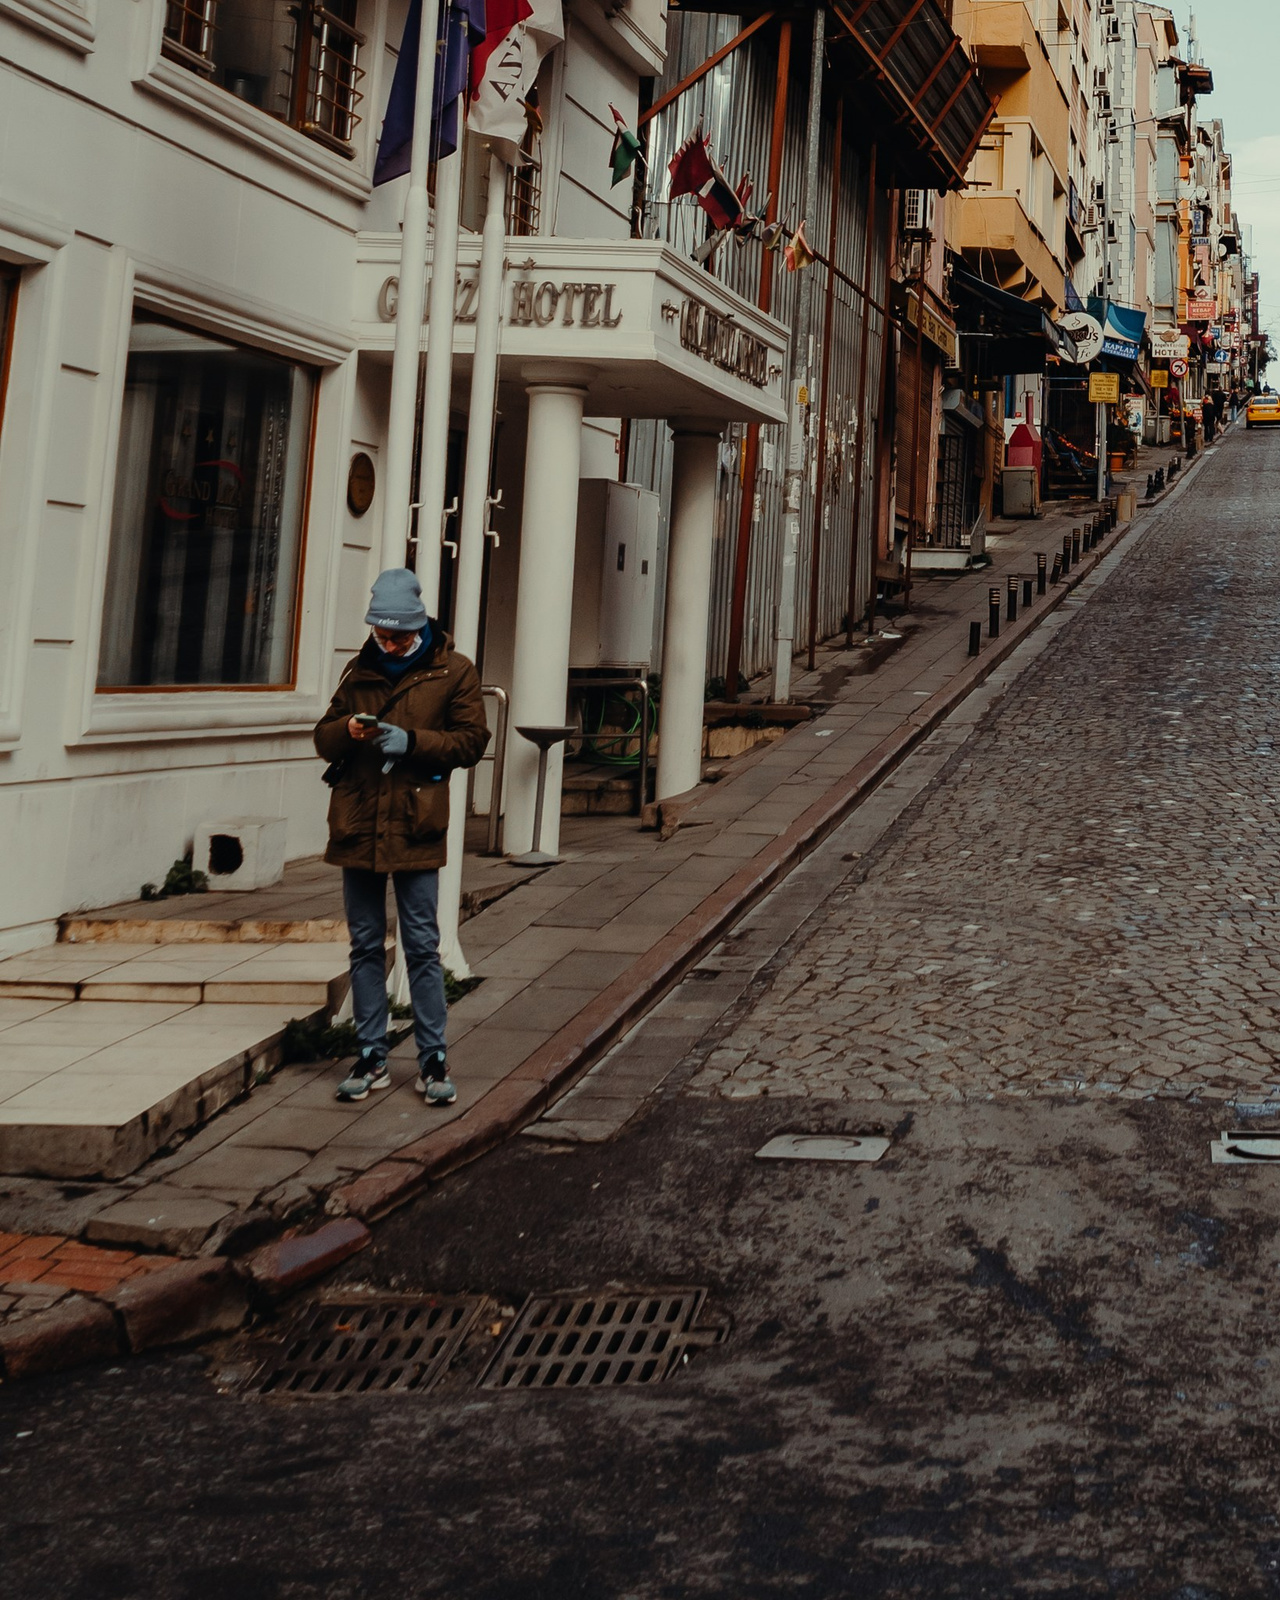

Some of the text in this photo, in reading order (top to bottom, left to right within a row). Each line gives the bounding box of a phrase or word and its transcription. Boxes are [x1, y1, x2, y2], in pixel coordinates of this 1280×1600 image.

[508, 281, 623, 328] HOTEL
[1104, 341, 1136, 354] KAPLAN
[377, 618, 400, 626] relax
